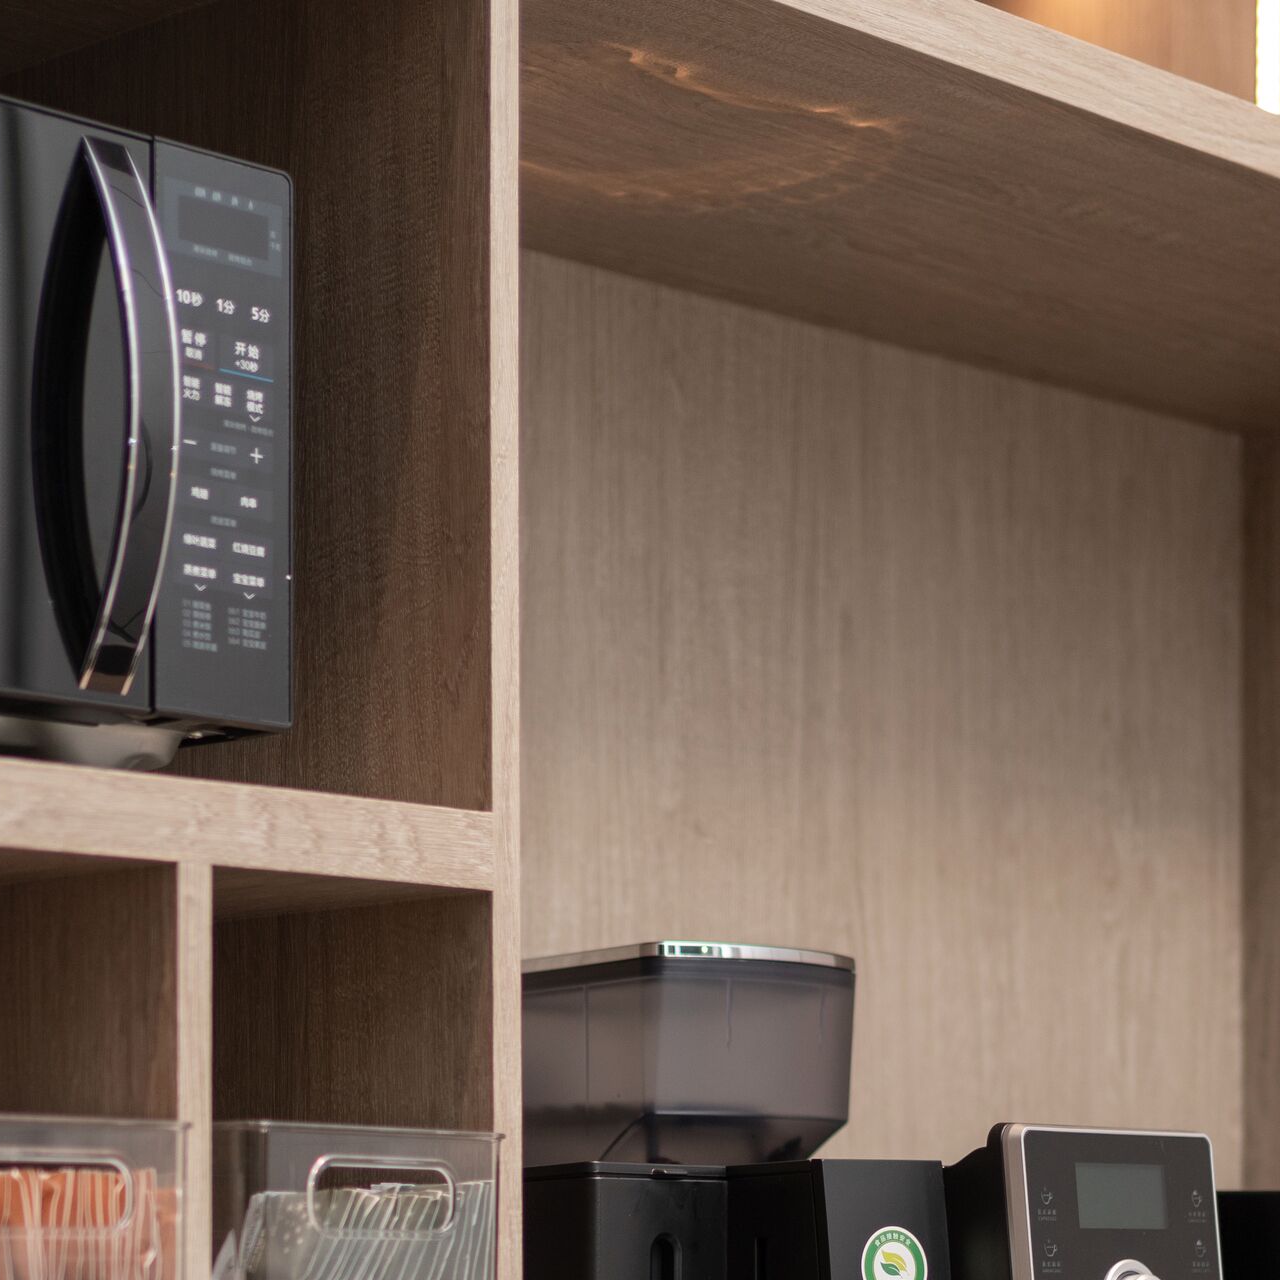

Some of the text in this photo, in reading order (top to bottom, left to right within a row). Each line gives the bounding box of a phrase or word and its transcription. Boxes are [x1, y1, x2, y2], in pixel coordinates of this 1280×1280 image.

[176, 289, 203, 307] 10秒
[216, 298, 235, 315] 1分
[251, 307, 270, 323] 5分
[235, 341, 259, 359] 开始
